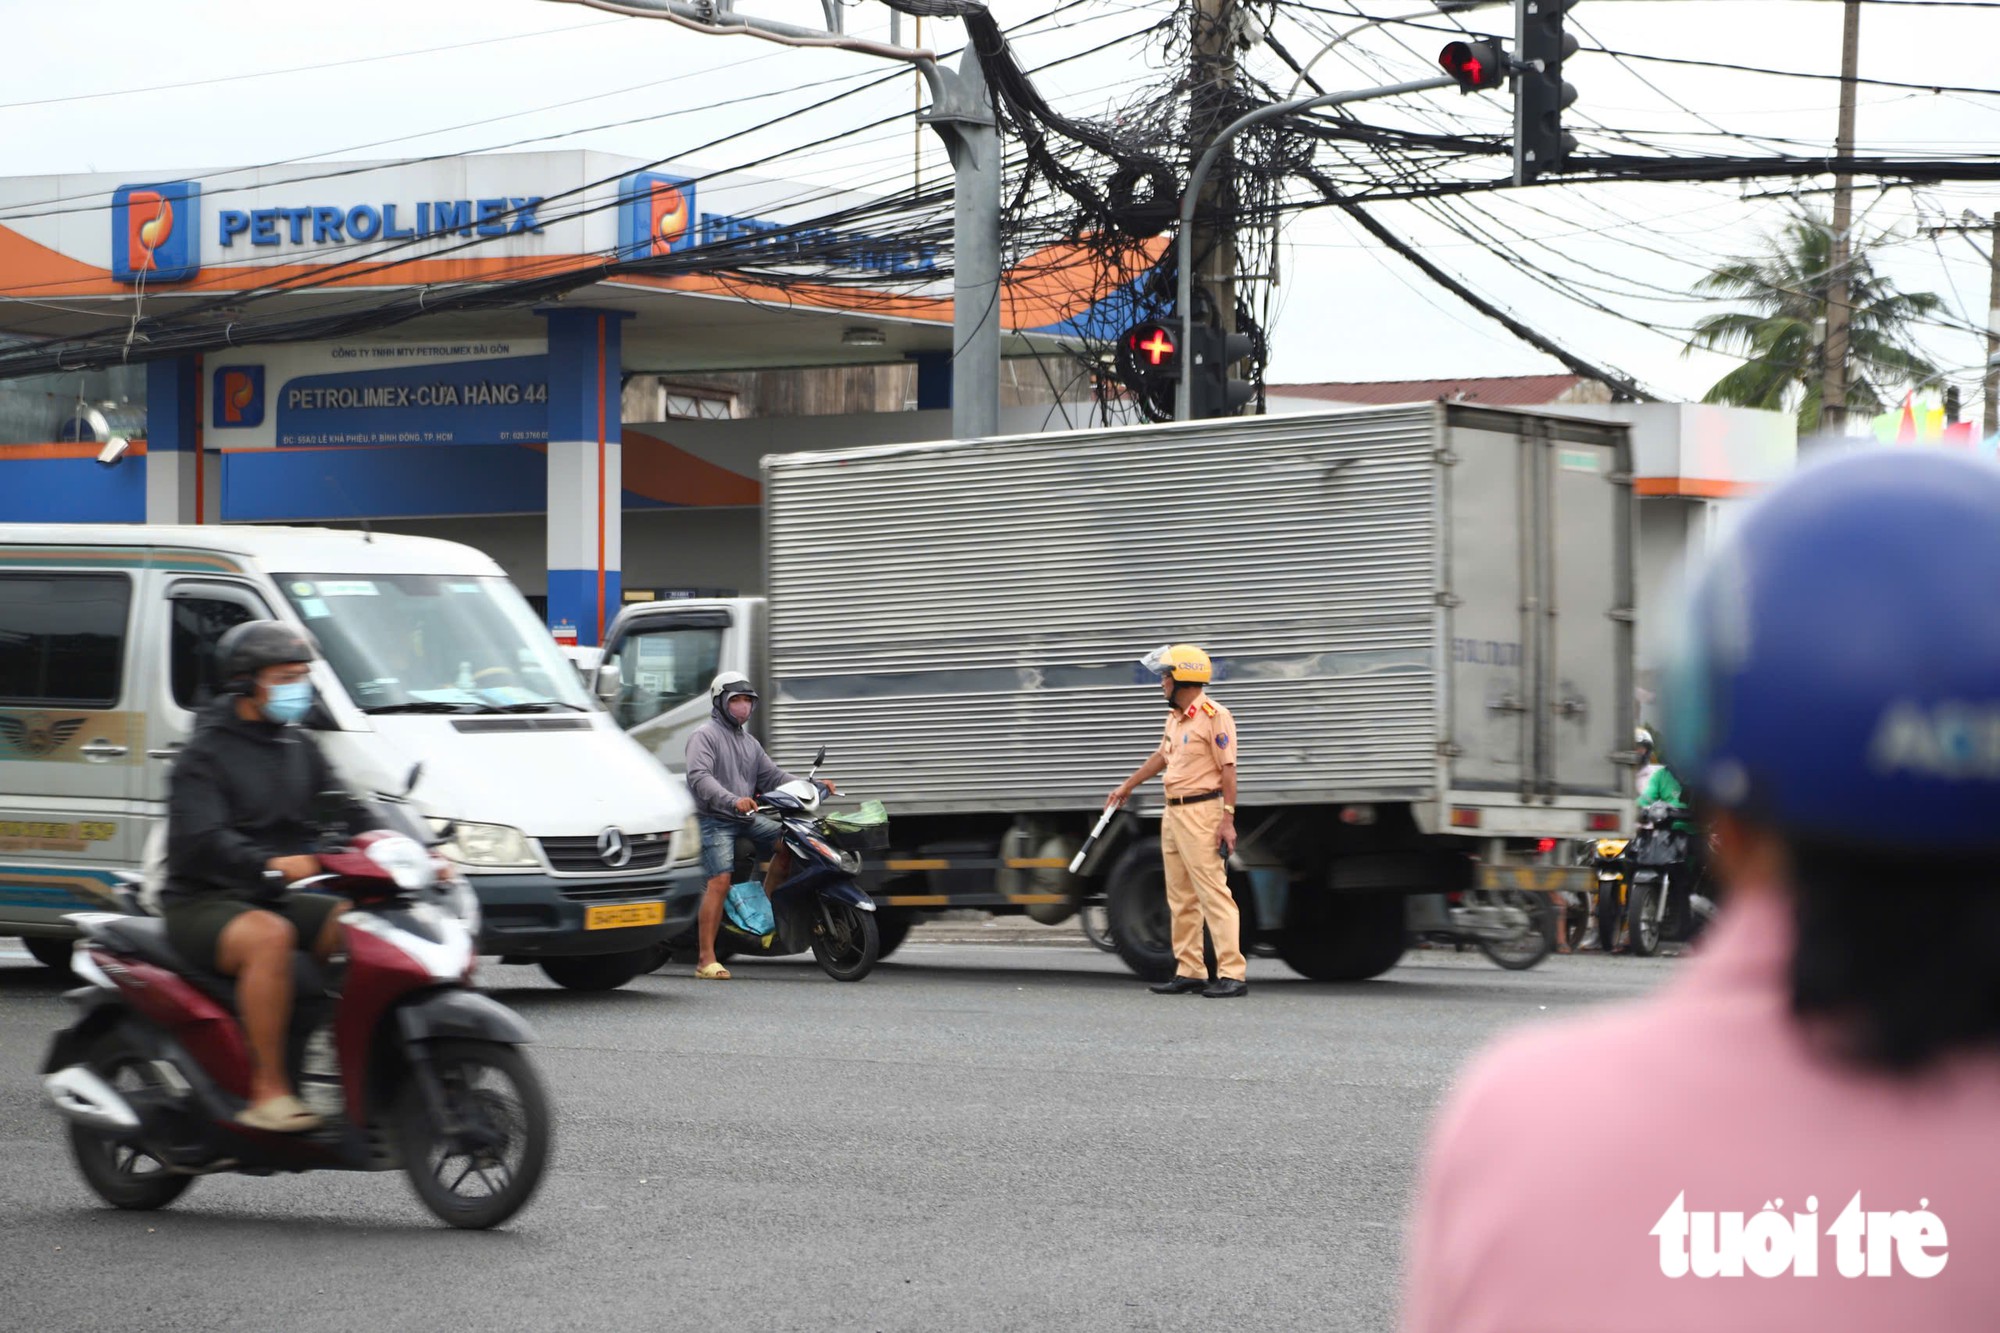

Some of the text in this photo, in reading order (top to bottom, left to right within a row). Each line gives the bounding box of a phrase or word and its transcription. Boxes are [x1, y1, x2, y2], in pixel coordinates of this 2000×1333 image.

[218, 196, 545, 247] PETROLIMEX
[331, 347, 357, 358] CÔNG
[359, 348, 369, 357] TY
[372, 347, 395, 357] TNHH
[397, 347, 415, 357] MTV
[416, 345, 471, 356] PETROLIMEX
[464, 380, 519, 406] HÀNG
[524, 384, 547, 403] 44
[436, 432, 453, 441] HCM
